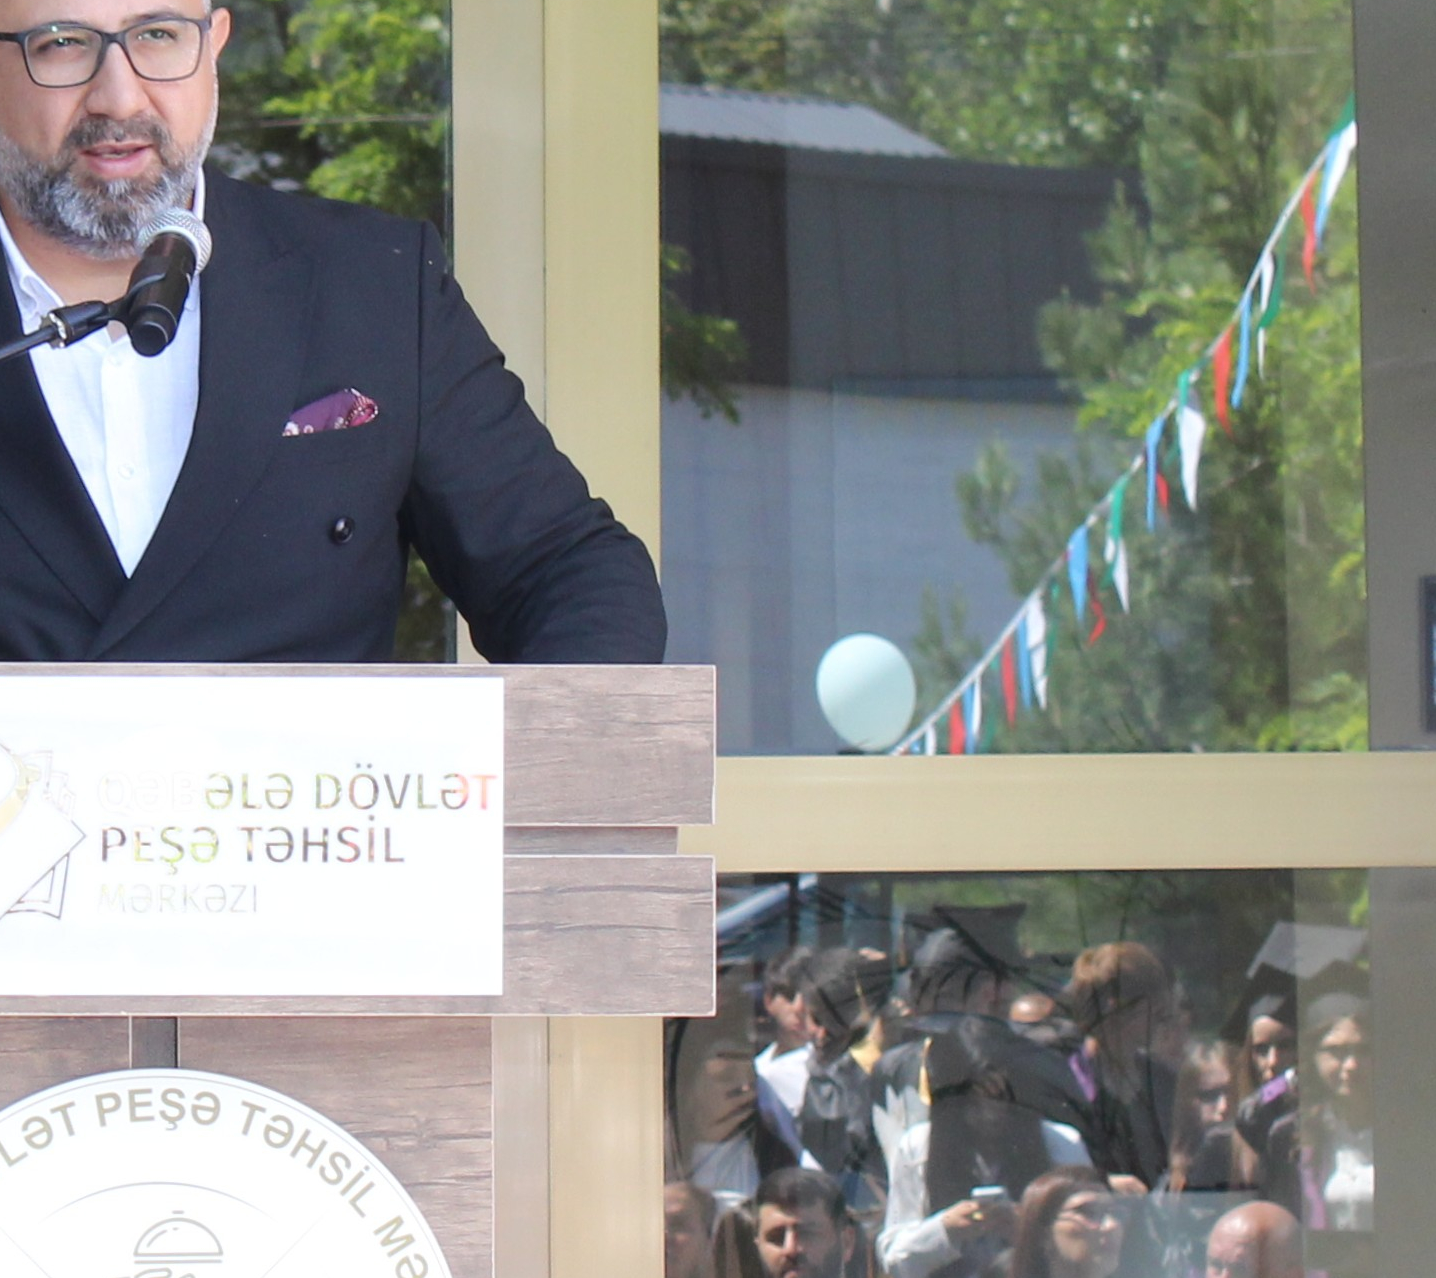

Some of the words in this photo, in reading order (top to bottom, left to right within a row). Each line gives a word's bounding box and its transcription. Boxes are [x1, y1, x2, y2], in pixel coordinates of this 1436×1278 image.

[314, 762, 497, 811] DÖVLƏT
[101, 826, 220, 875] PEŞƏ
[239, 813, 405, 863] TƏHSİL
[95, 1088, 221, 1131] PEŞƏ
[241, 1100, 375, 1218] TƏHSİL
